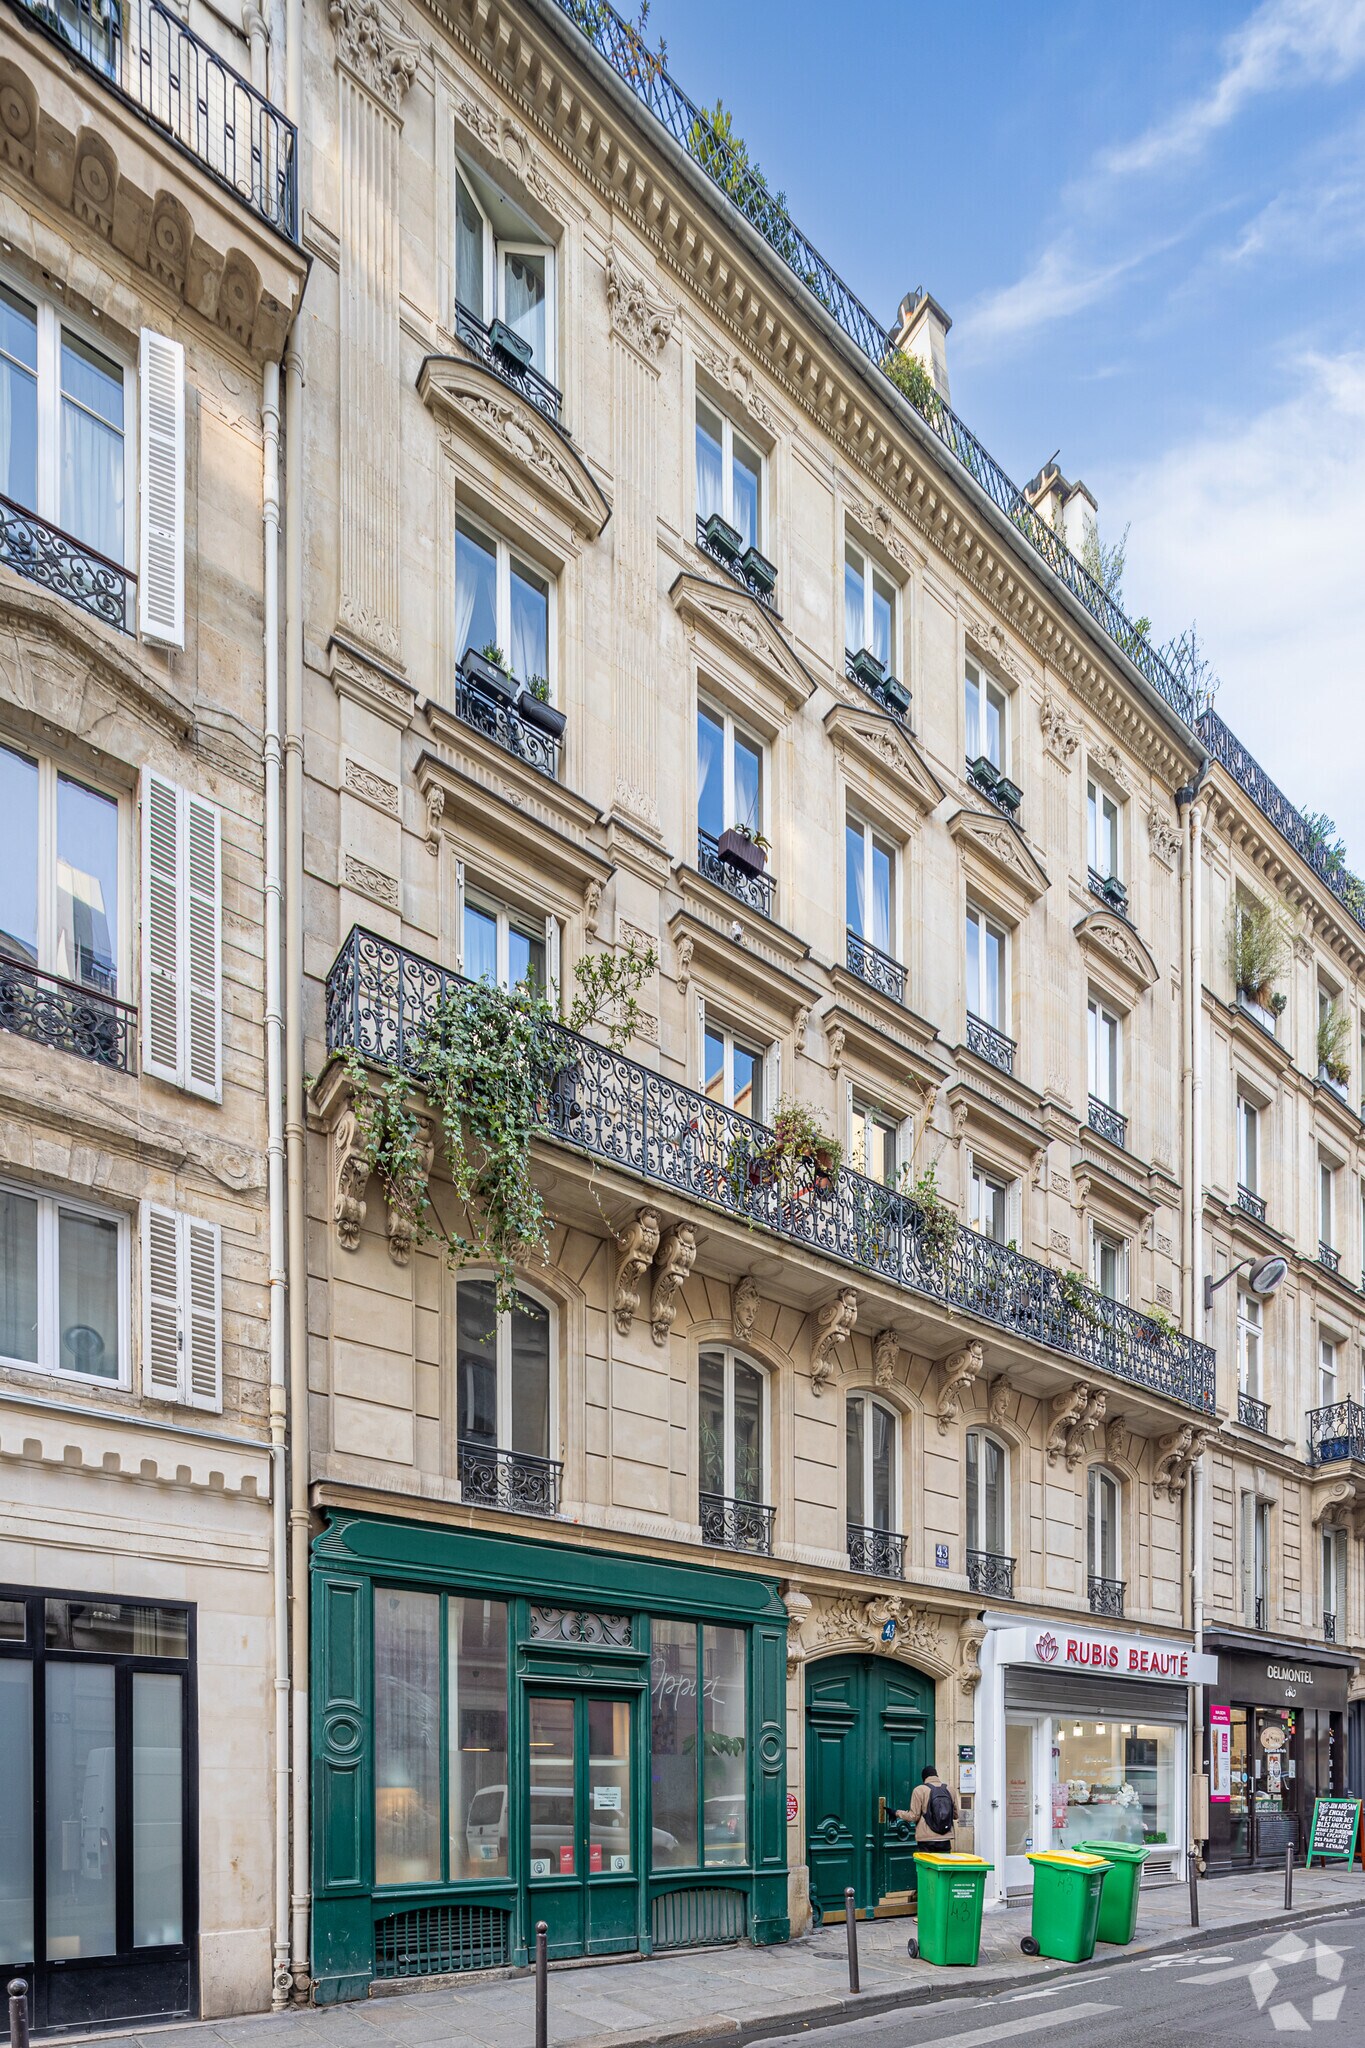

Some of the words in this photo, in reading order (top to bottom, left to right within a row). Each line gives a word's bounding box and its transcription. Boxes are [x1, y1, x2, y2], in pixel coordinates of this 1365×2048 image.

[937, 1545, 948, 1559] 43
[885, 1624, 896, 1638] 43
[1066, 1639, 1119, 1668] RUBIS
[1128, 1648, 1189, 1677] BEAUTÉ
[1267, 1665, 1314, 1684] DELMONTEL
